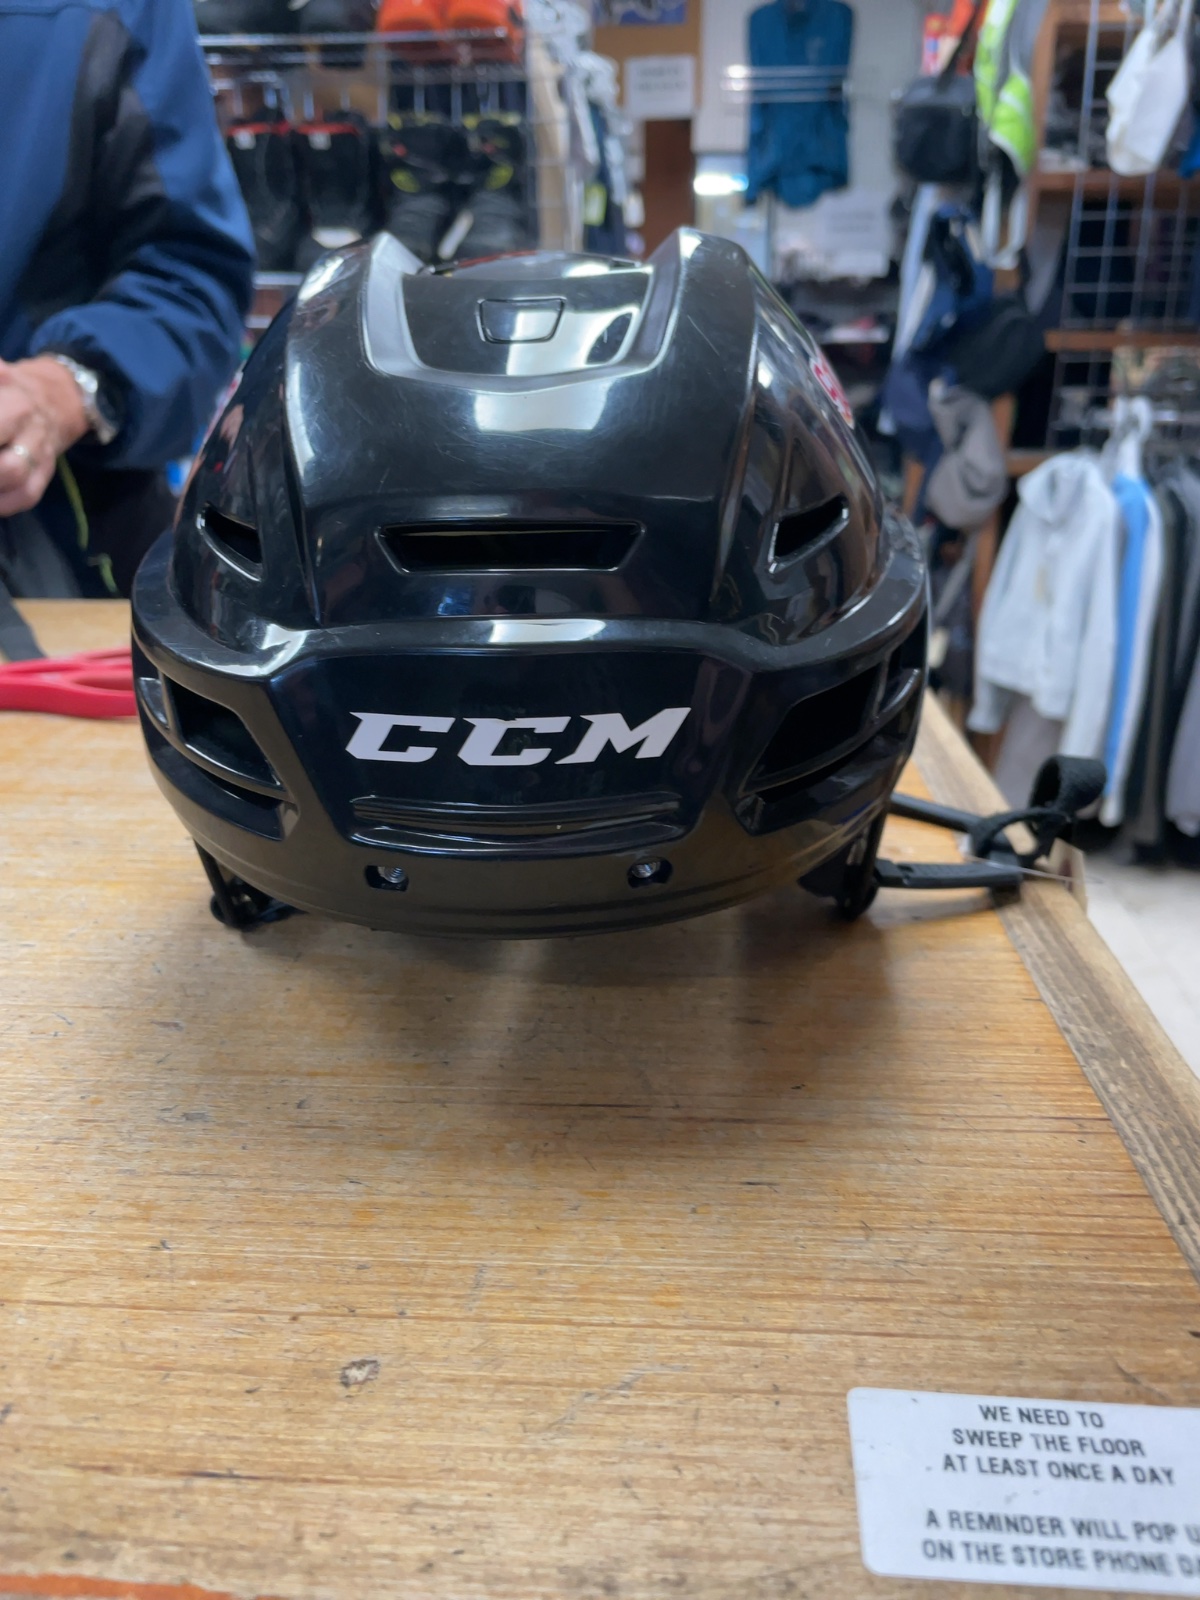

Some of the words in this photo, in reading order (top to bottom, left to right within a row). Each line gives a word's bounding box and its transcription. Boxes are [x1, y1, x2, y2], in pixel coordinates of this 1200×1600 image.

[345, 707, 692, 766] CCM
[979, 1404, 1012, 1423] WE
[1018, 1407, 1070, 1427] NEED
[1076, 1410, 1105, 1429] TO
[952, 1428, 1023, 1448] SWEEP
[1030, 1433, 1071, 1452] THE
[1078, 1436, 1147, 1457] FLOOR
[943, 1454, 968, 1473] AT
[976, 1456, 1039, 1478] LEAST
[1048, 1461, 1106, 1482] ONCE
[1112, 1466, 1126, 1484] A
[1133, 1466, 1176, 1486] DAY
[926, 1509, 941, 1529] A
[948, 1510, 1066, 1537] REMINDER
[1071, 1517, 1128, 1541] WILL
[1132, 1520, 1177, 1544] POP
[922, 1539, 954, 1561] ON
[962, 1541, 1006, 1566] THE
[1012, 1545, 1088, 1571] STORE
[1093, 1549, 1173, 1576] PHONE
